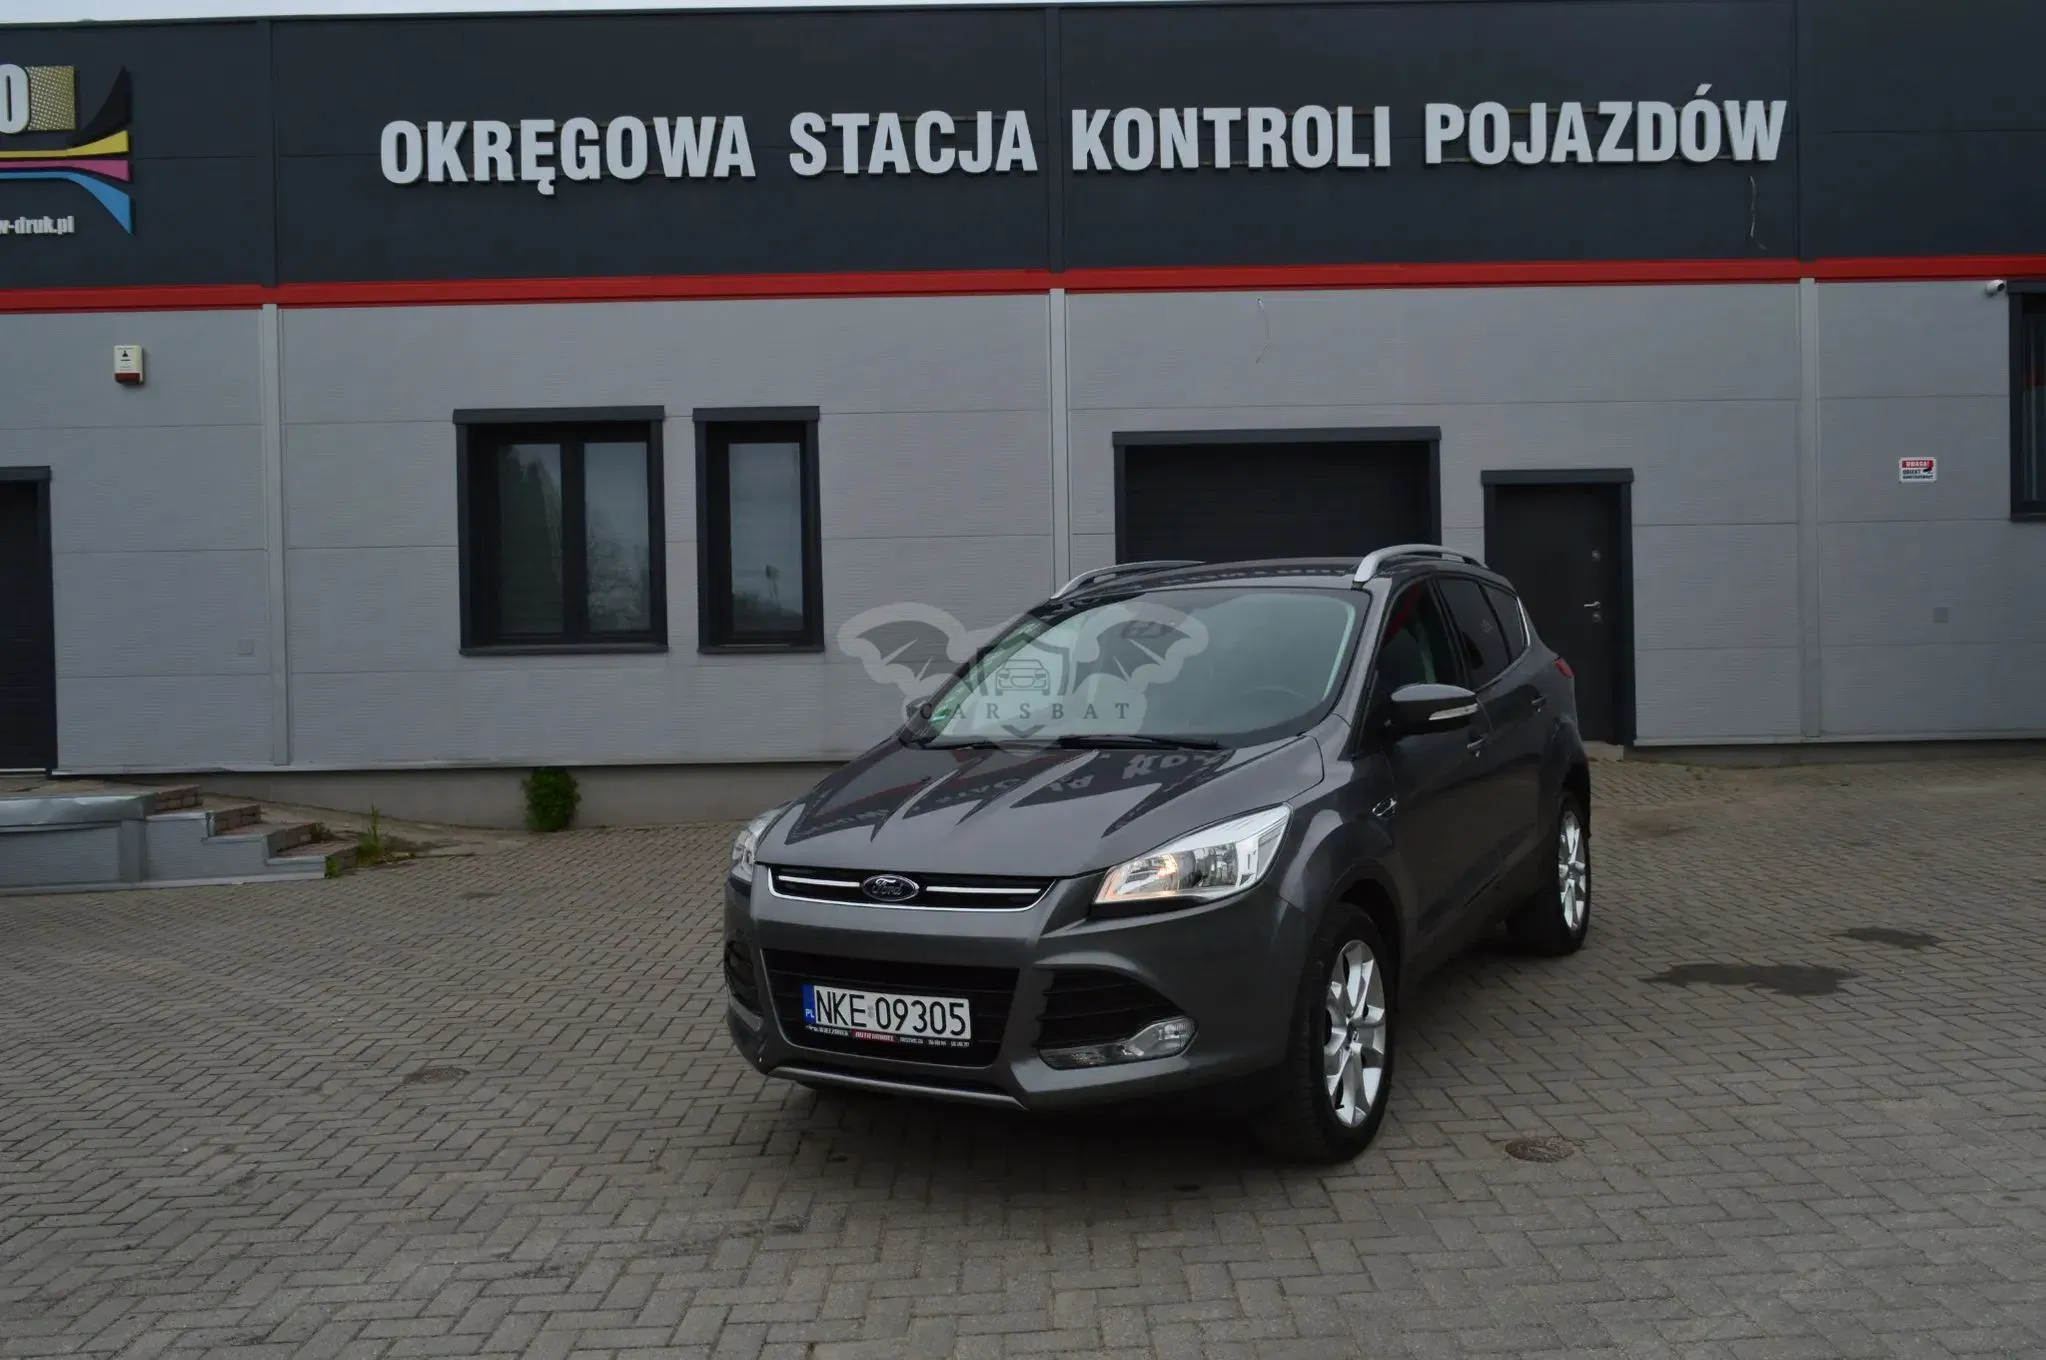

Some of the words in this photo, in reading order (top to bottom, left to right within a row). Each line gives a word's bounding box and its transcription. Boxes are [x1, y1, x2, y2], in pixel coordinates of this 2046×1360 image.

[380, 115, 756, 196] OKRĘGOWA
[789, 110, 1039, 176] STACJA
[1071, 105, 1391, 171] KONTROLI
[1423, 83, 1788, 165] POJAZDÓW
[871, 877, 905, 896] Ford
[804, 1008, 815, 1019] PL
[815, 989, 867, 1029] NKE
[874, 996, 966, 1036] 09305
